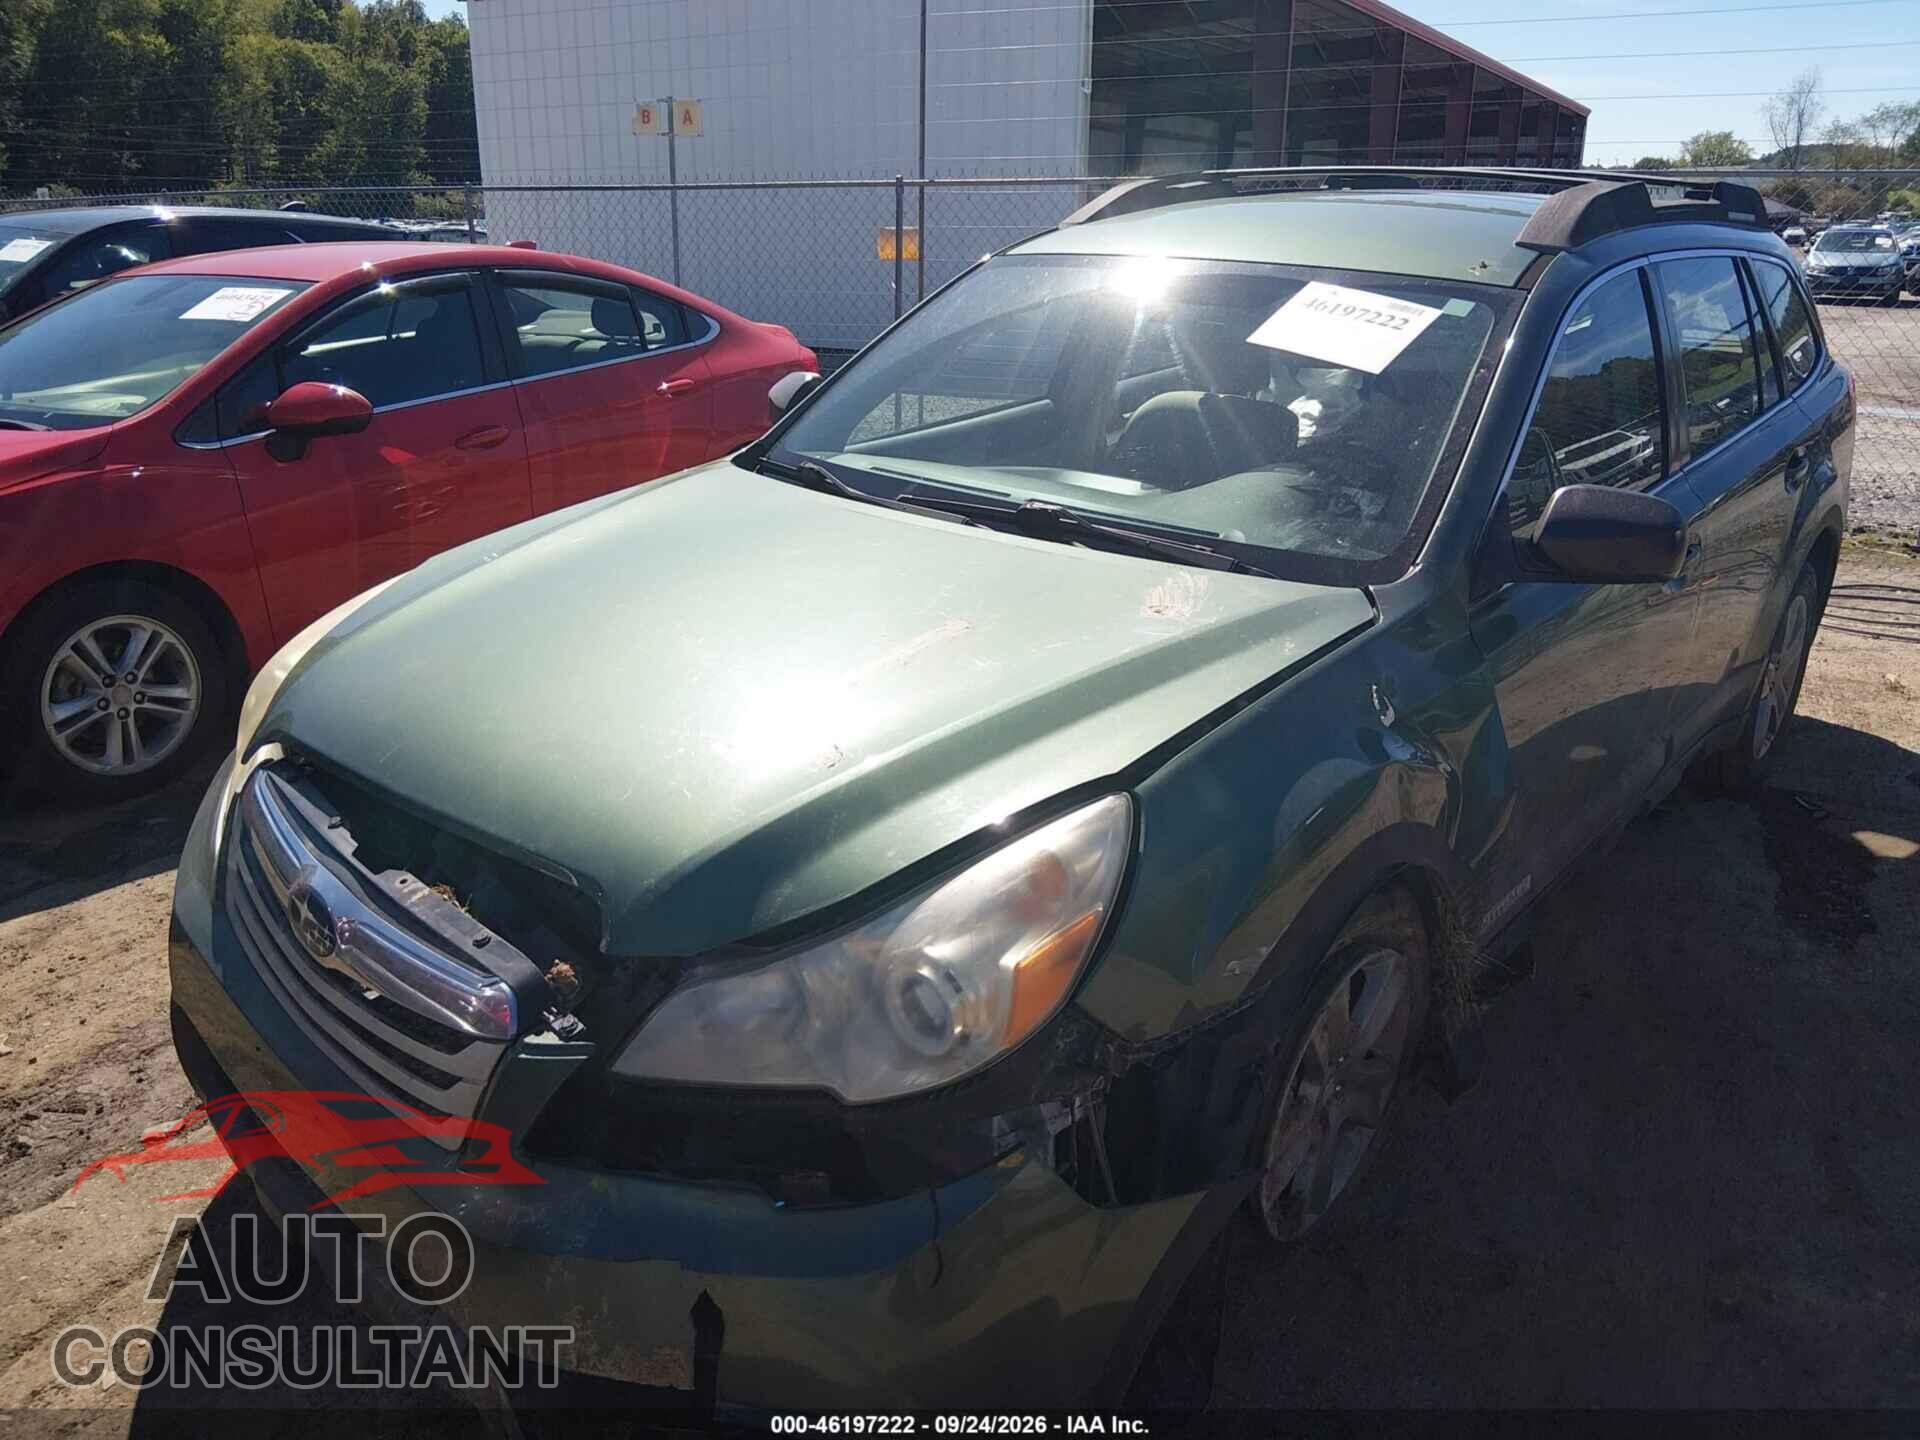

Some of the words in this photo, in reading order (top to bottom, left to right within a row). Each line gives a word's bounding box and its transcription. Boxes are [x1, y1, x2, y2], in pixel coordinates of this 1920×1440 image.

[641, 108, 651, 125] B
[682, 107, 694, 126] A
[1304, 297, 1411, 331] 46197222
